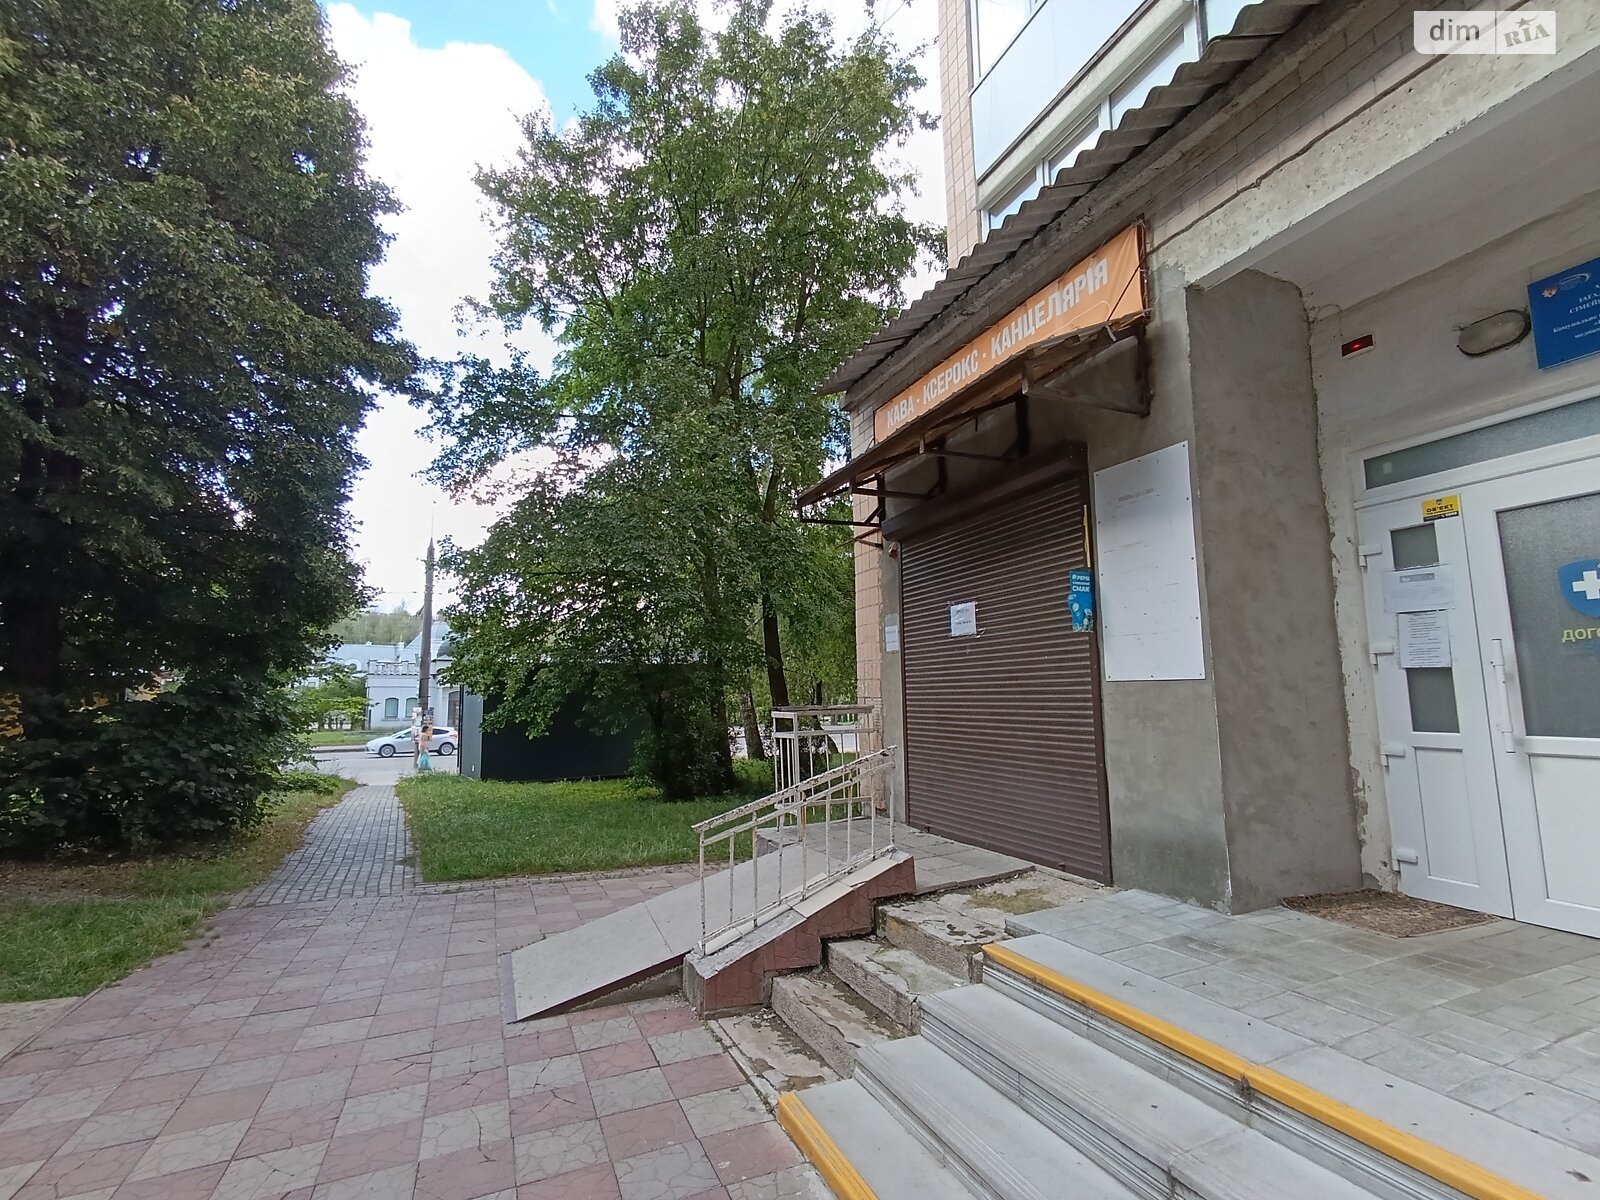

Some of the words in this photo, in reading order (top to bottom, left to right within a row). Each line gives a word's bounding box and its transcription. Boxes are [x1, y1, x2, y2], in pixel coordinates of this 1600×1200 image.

[887, 395, 914, 429] КАВА
[923, 349, 979, 405] КСЕРОКС
[991, 257, 1109, 360] КАНЦЕЛЯРІЯ
